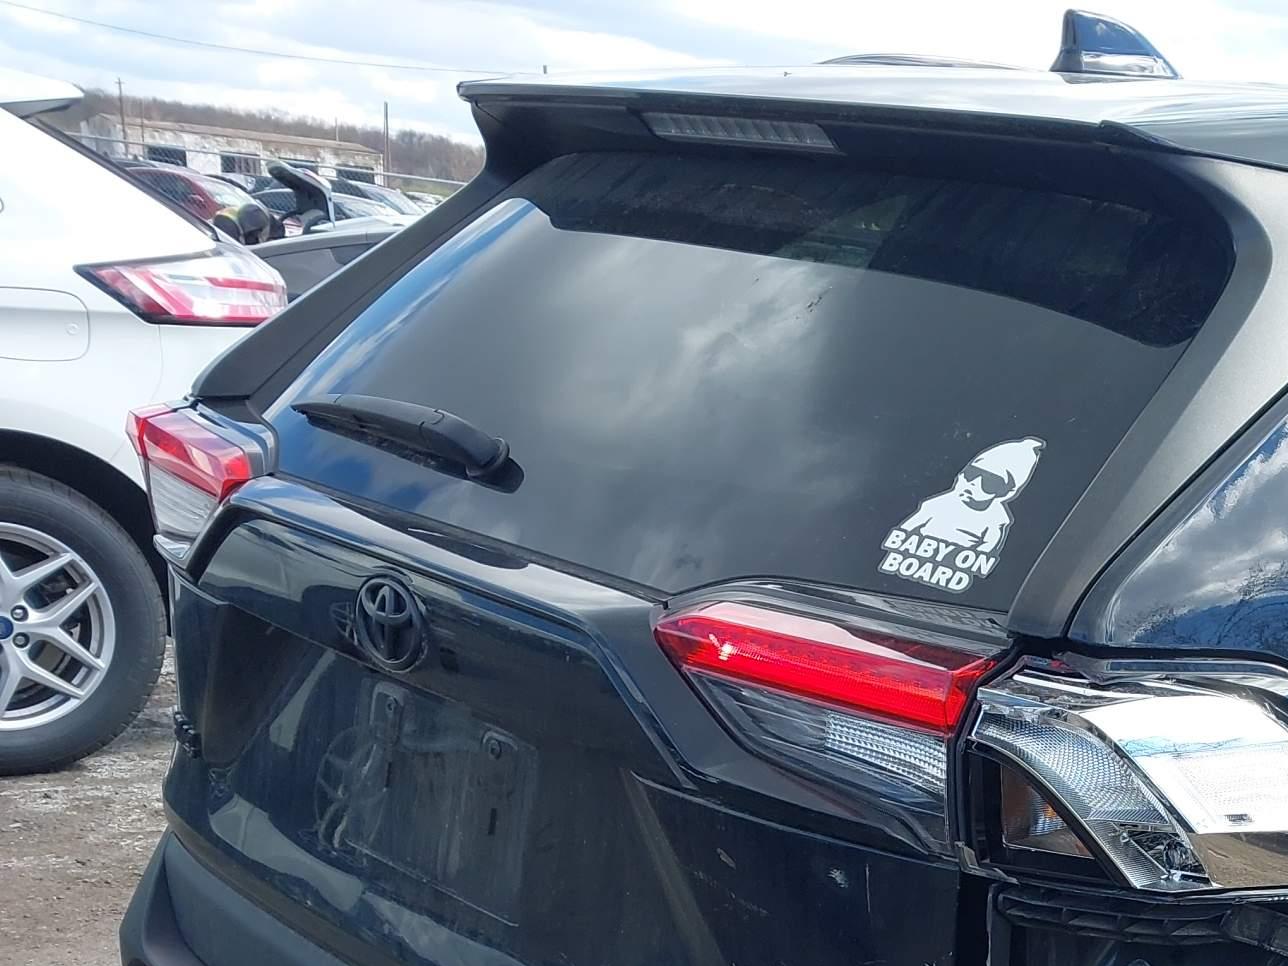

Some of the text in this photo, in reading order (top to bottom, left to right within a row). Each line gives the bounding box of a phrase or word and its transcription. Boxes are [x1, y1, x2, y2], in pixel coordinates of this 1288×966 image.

[881, 552, 970, 591] BOARD
[884, 530, 996, 575] BABY ON
